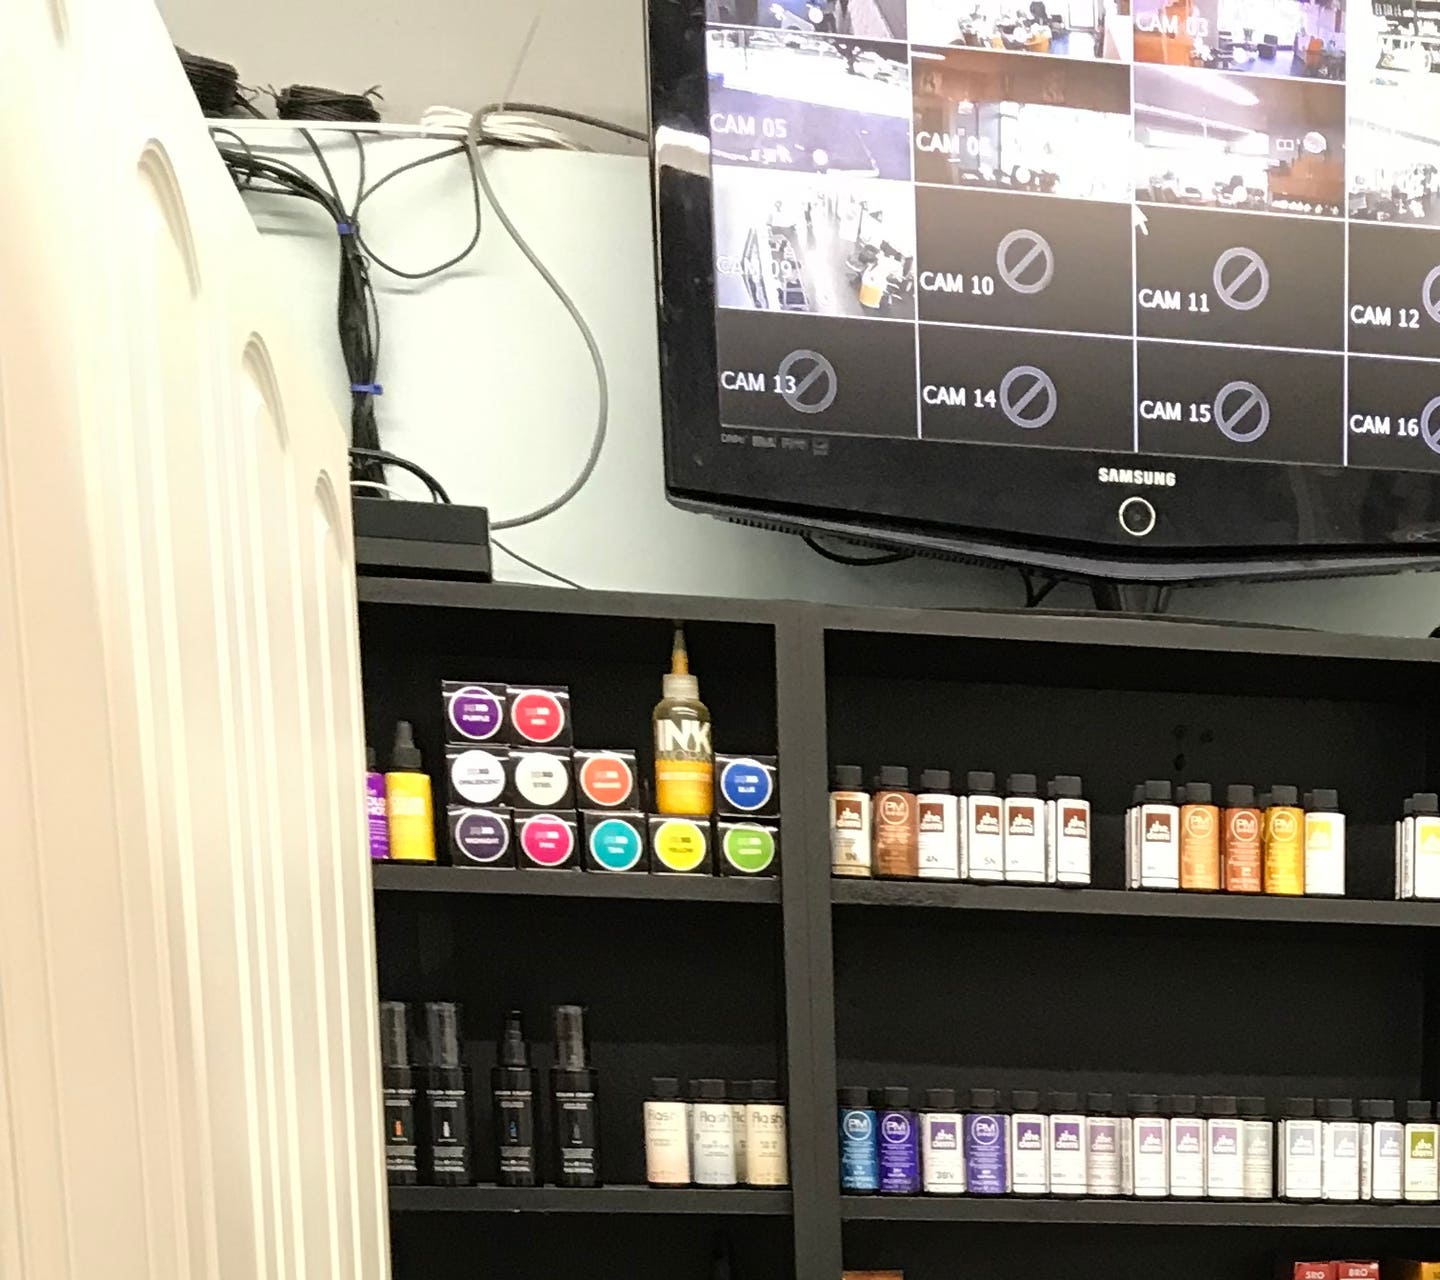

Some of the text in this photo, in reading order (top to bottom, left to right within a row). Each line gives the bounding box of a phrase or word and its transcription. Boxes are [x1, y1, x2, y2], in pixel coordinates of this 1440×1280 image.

[1135, 13, 1208, 37] CAM 03
[710, 113, 787, 138] CAM 05
[916, 131, 960, 154] CAM
[919, 272, 994, 295] CAM 10
[1138, 288, 1210, 313] CAM 11
[1350, 305, 1420, 328] CAM 12
[720, 370, 796, 394] CAM 13
[922, 386, 996, 409] CAM 14
[1139, 400, 1211, 423] CAM 15
[1350, 414, 1419, 437] CAM 16
[1098, 467, 1176, 486] SAMSUNG
[656, 719, 712, 753] INK
[752, 1110, 784, 1123] flash
